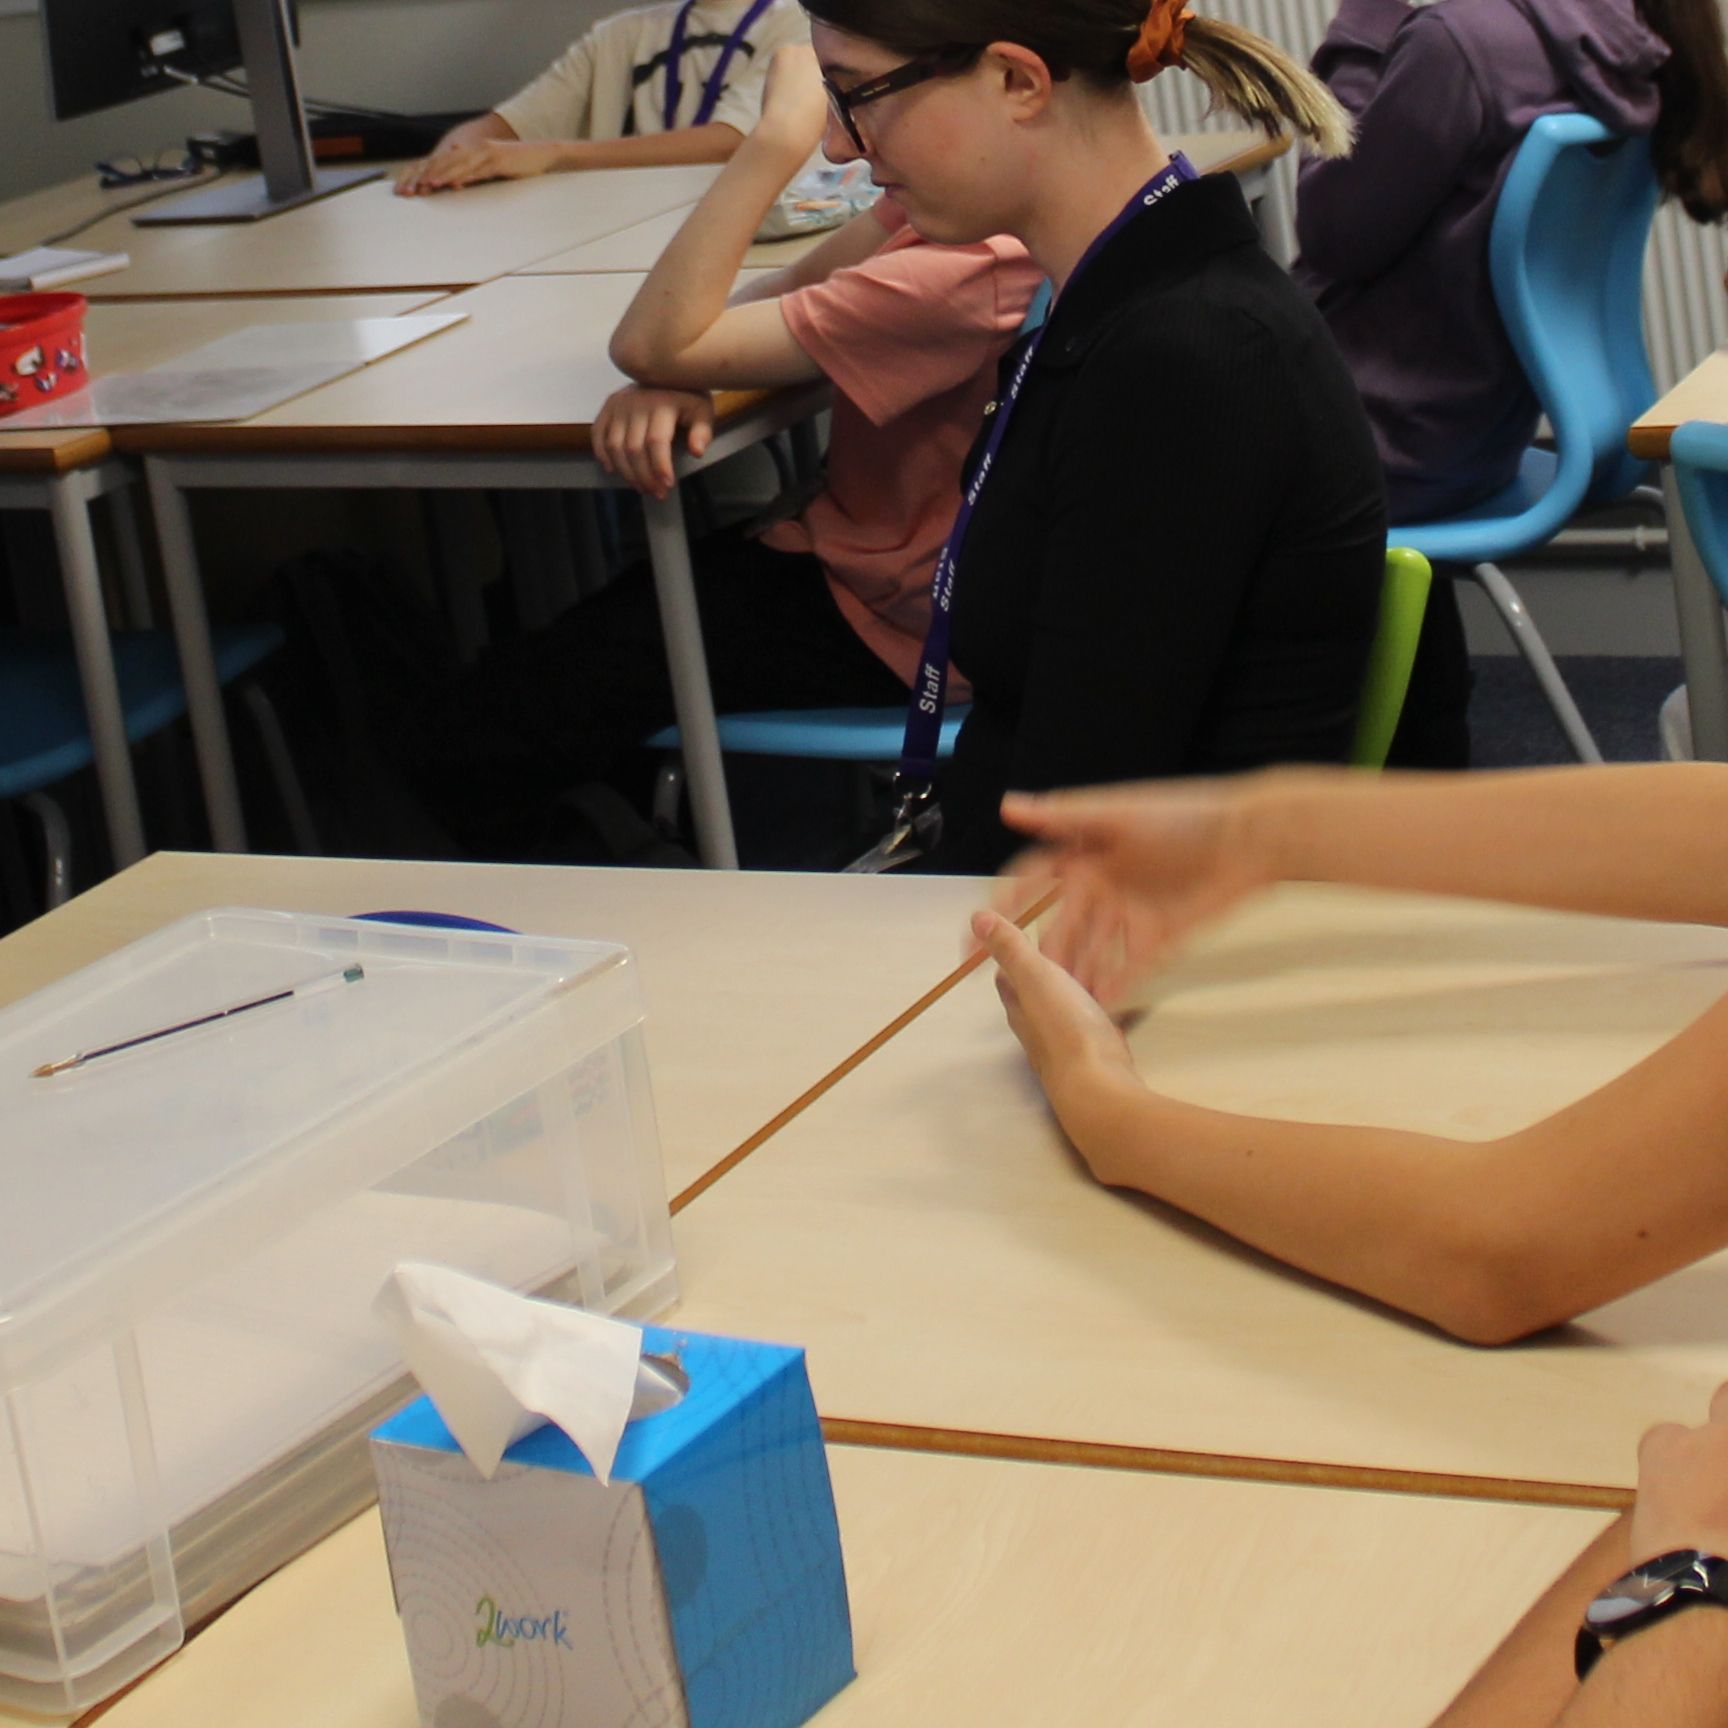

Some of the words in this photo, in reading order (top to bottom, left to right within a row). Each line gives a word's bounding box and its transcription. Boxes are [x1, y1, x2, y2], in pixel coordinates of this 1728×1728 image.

[1143, 174, 1180, 206] Staff
[939, 557, 958, 613] Staff
[918, 662, 941, 715] Staff
[475, 1594, 573, 1650] 2work
